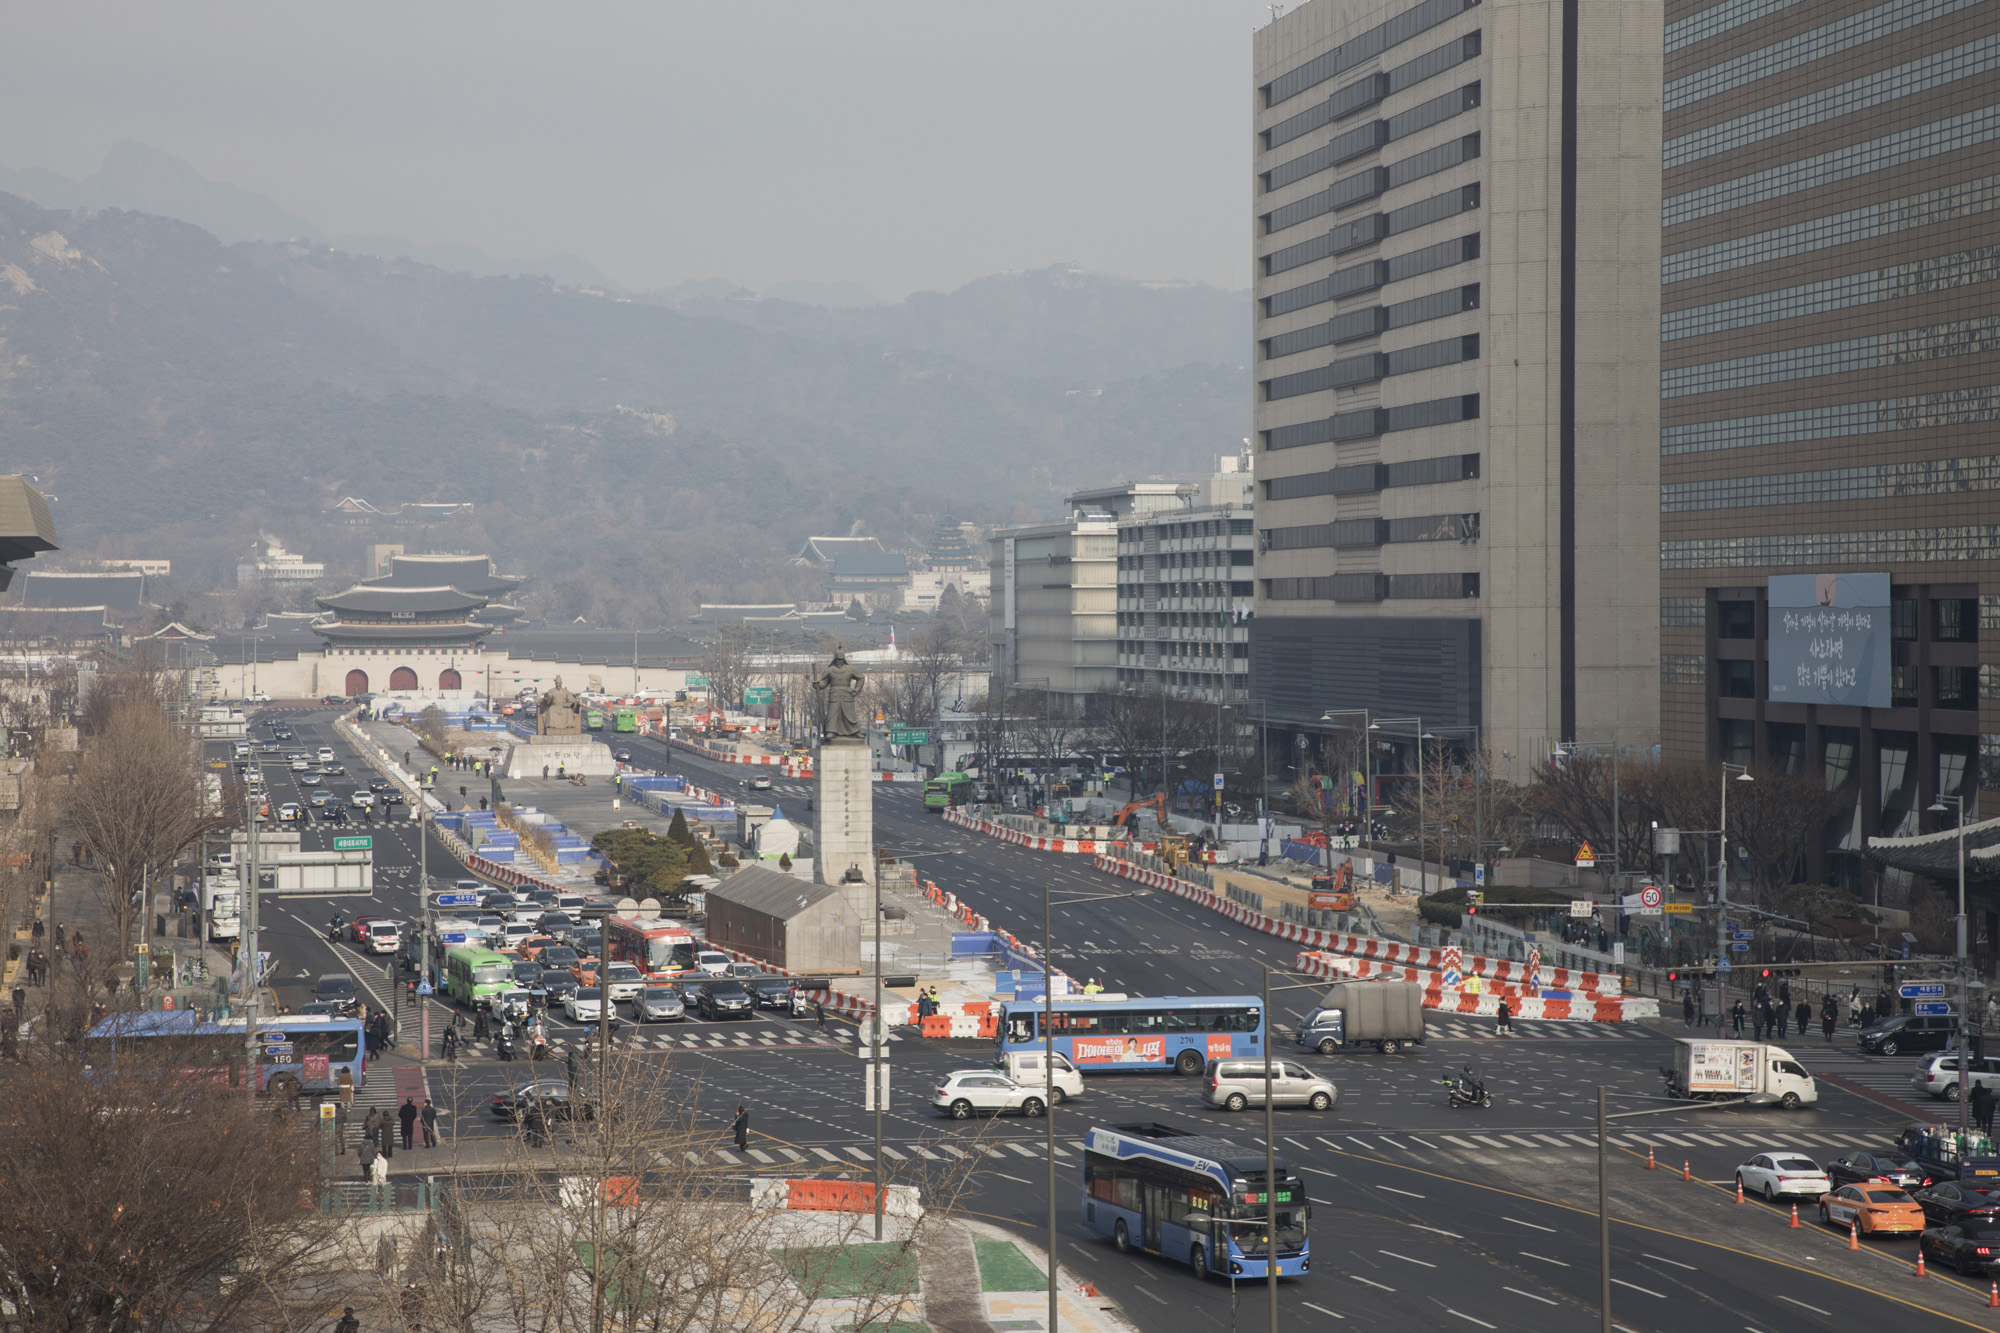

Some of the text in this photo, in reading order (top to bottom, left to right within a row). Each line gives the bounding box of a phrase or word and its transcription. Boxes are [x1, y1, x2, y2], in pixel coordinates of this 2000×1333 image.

[1817, 610, 1836, 633] 살아갈
[1809, 636, 1843, 660] 사노라면
[1797, 662, 1857, 690] 많은 기쁨이 있다고
[544, 751, 580, 760] 세종대왕
[1645, 892, 1658, 903] 50
[1179, 1036, 1194, 1045] 270
[1078, 1041, 1161, 1059] 다이어트의 시작
[273, 1055, 292, 1064] 150
[1195, 1160, 1210, 1171] EV
[1192, 1196, 1208, 1210] 602
[1245, 1192, 1257, 1203] 602
